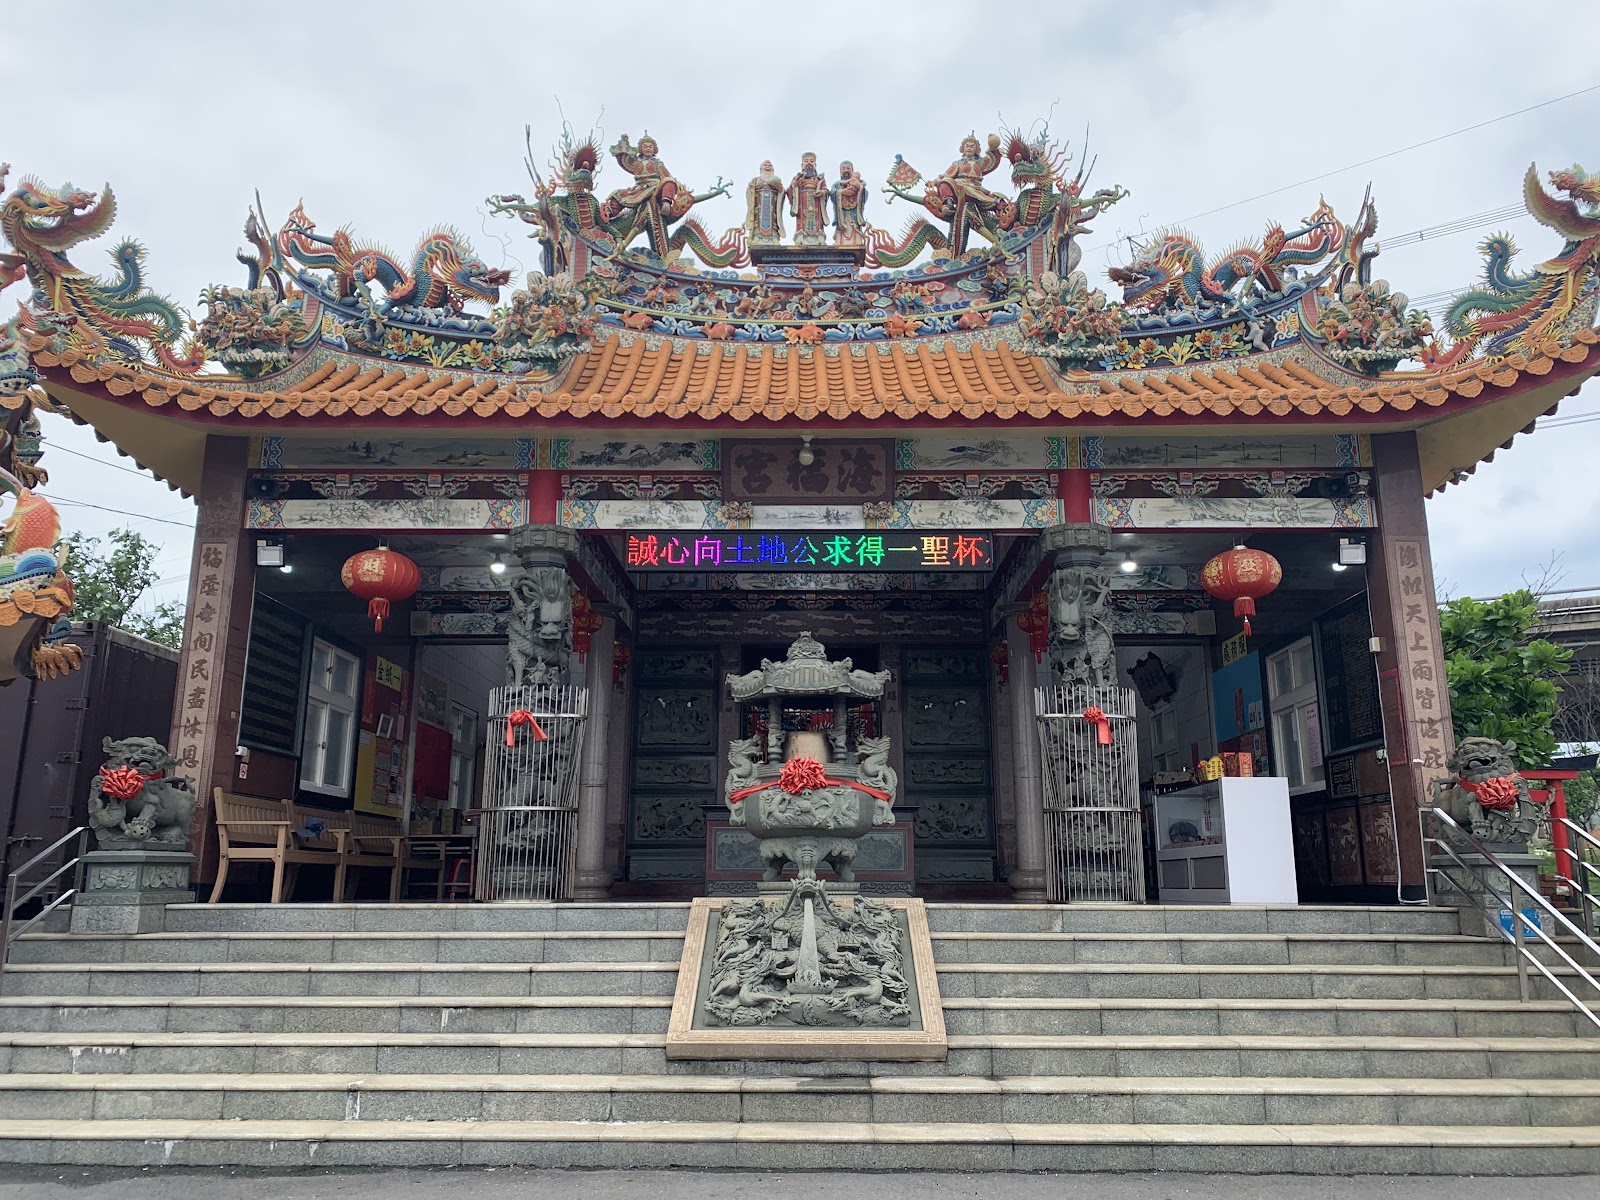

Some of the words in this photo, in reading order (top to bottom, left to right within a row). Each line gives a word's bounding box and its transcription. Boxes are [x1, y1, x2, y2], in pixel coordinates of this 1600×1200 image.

[627, 534, 991, 566] 誠心向土地公求得一聖杯
[180, 547, 222, 784] 福蔭世間民盡沐恩
